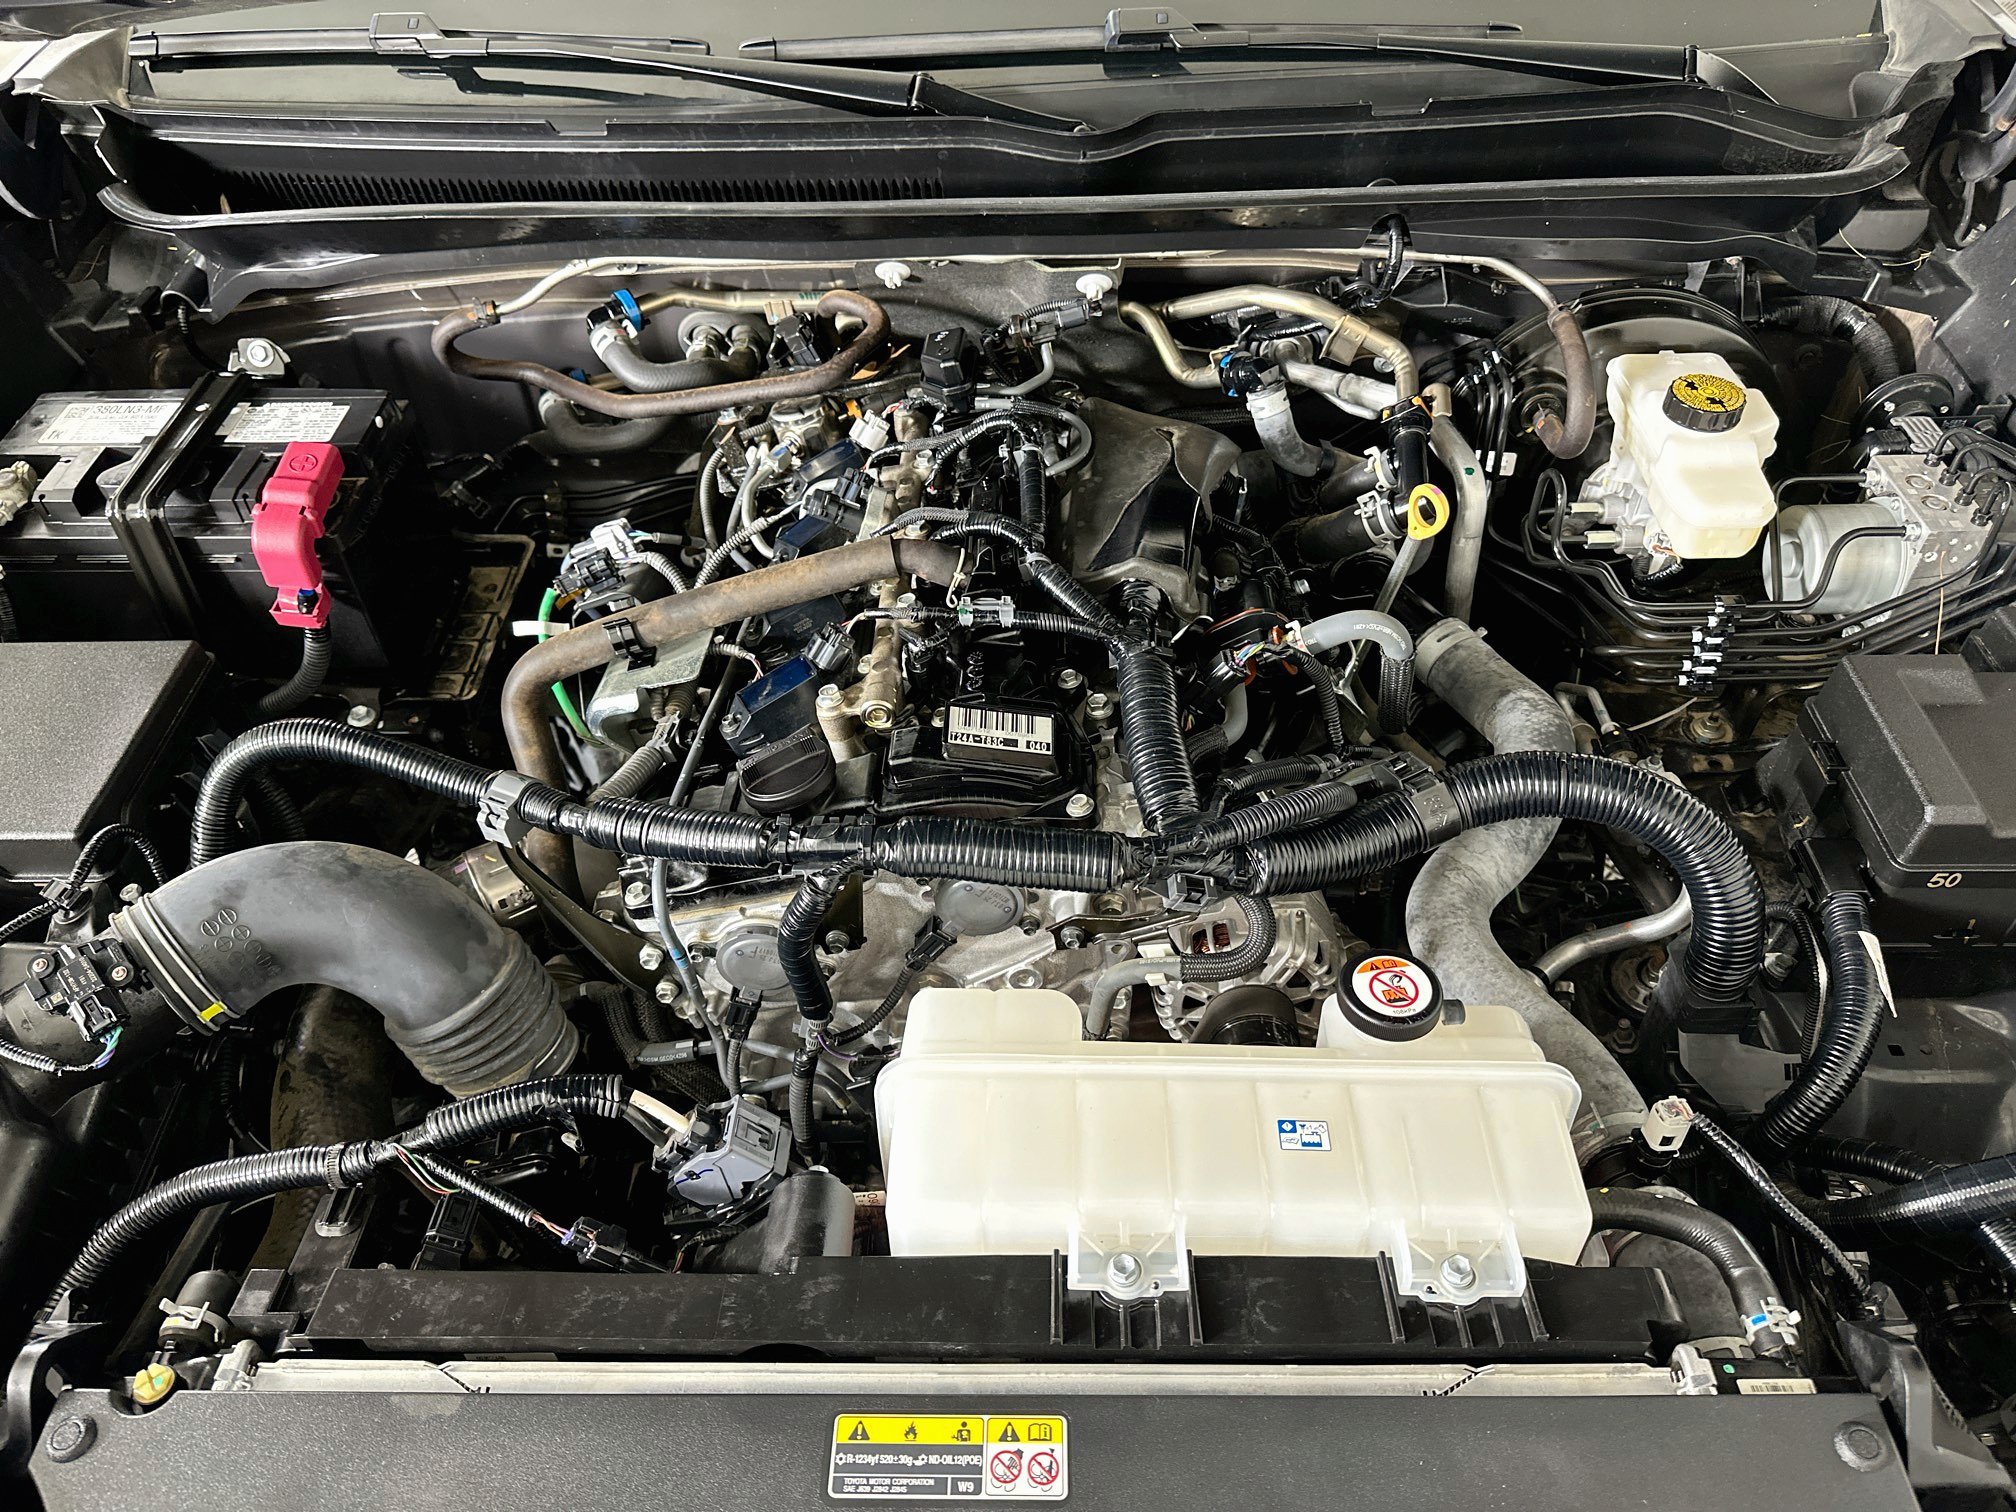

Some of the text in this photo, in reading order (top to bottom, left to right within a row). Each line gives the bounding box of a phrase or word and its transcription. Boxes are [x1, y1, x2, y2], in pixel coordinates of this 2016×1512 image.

[951, 732, 1004, 747] T24A-T83C
[1029, 742, 1047, 751] 040
[1926, 872, 1963, 888] 50
[847, 1454, 879, 1466] R-1234yf
[880, 1454, 913, 1466] 520±30g
[844, 1477, 867, 1485] TOYOTA
[892, 1478, 935, 1486] CORPORATION
[957, 1481, 975, 1493] W9
